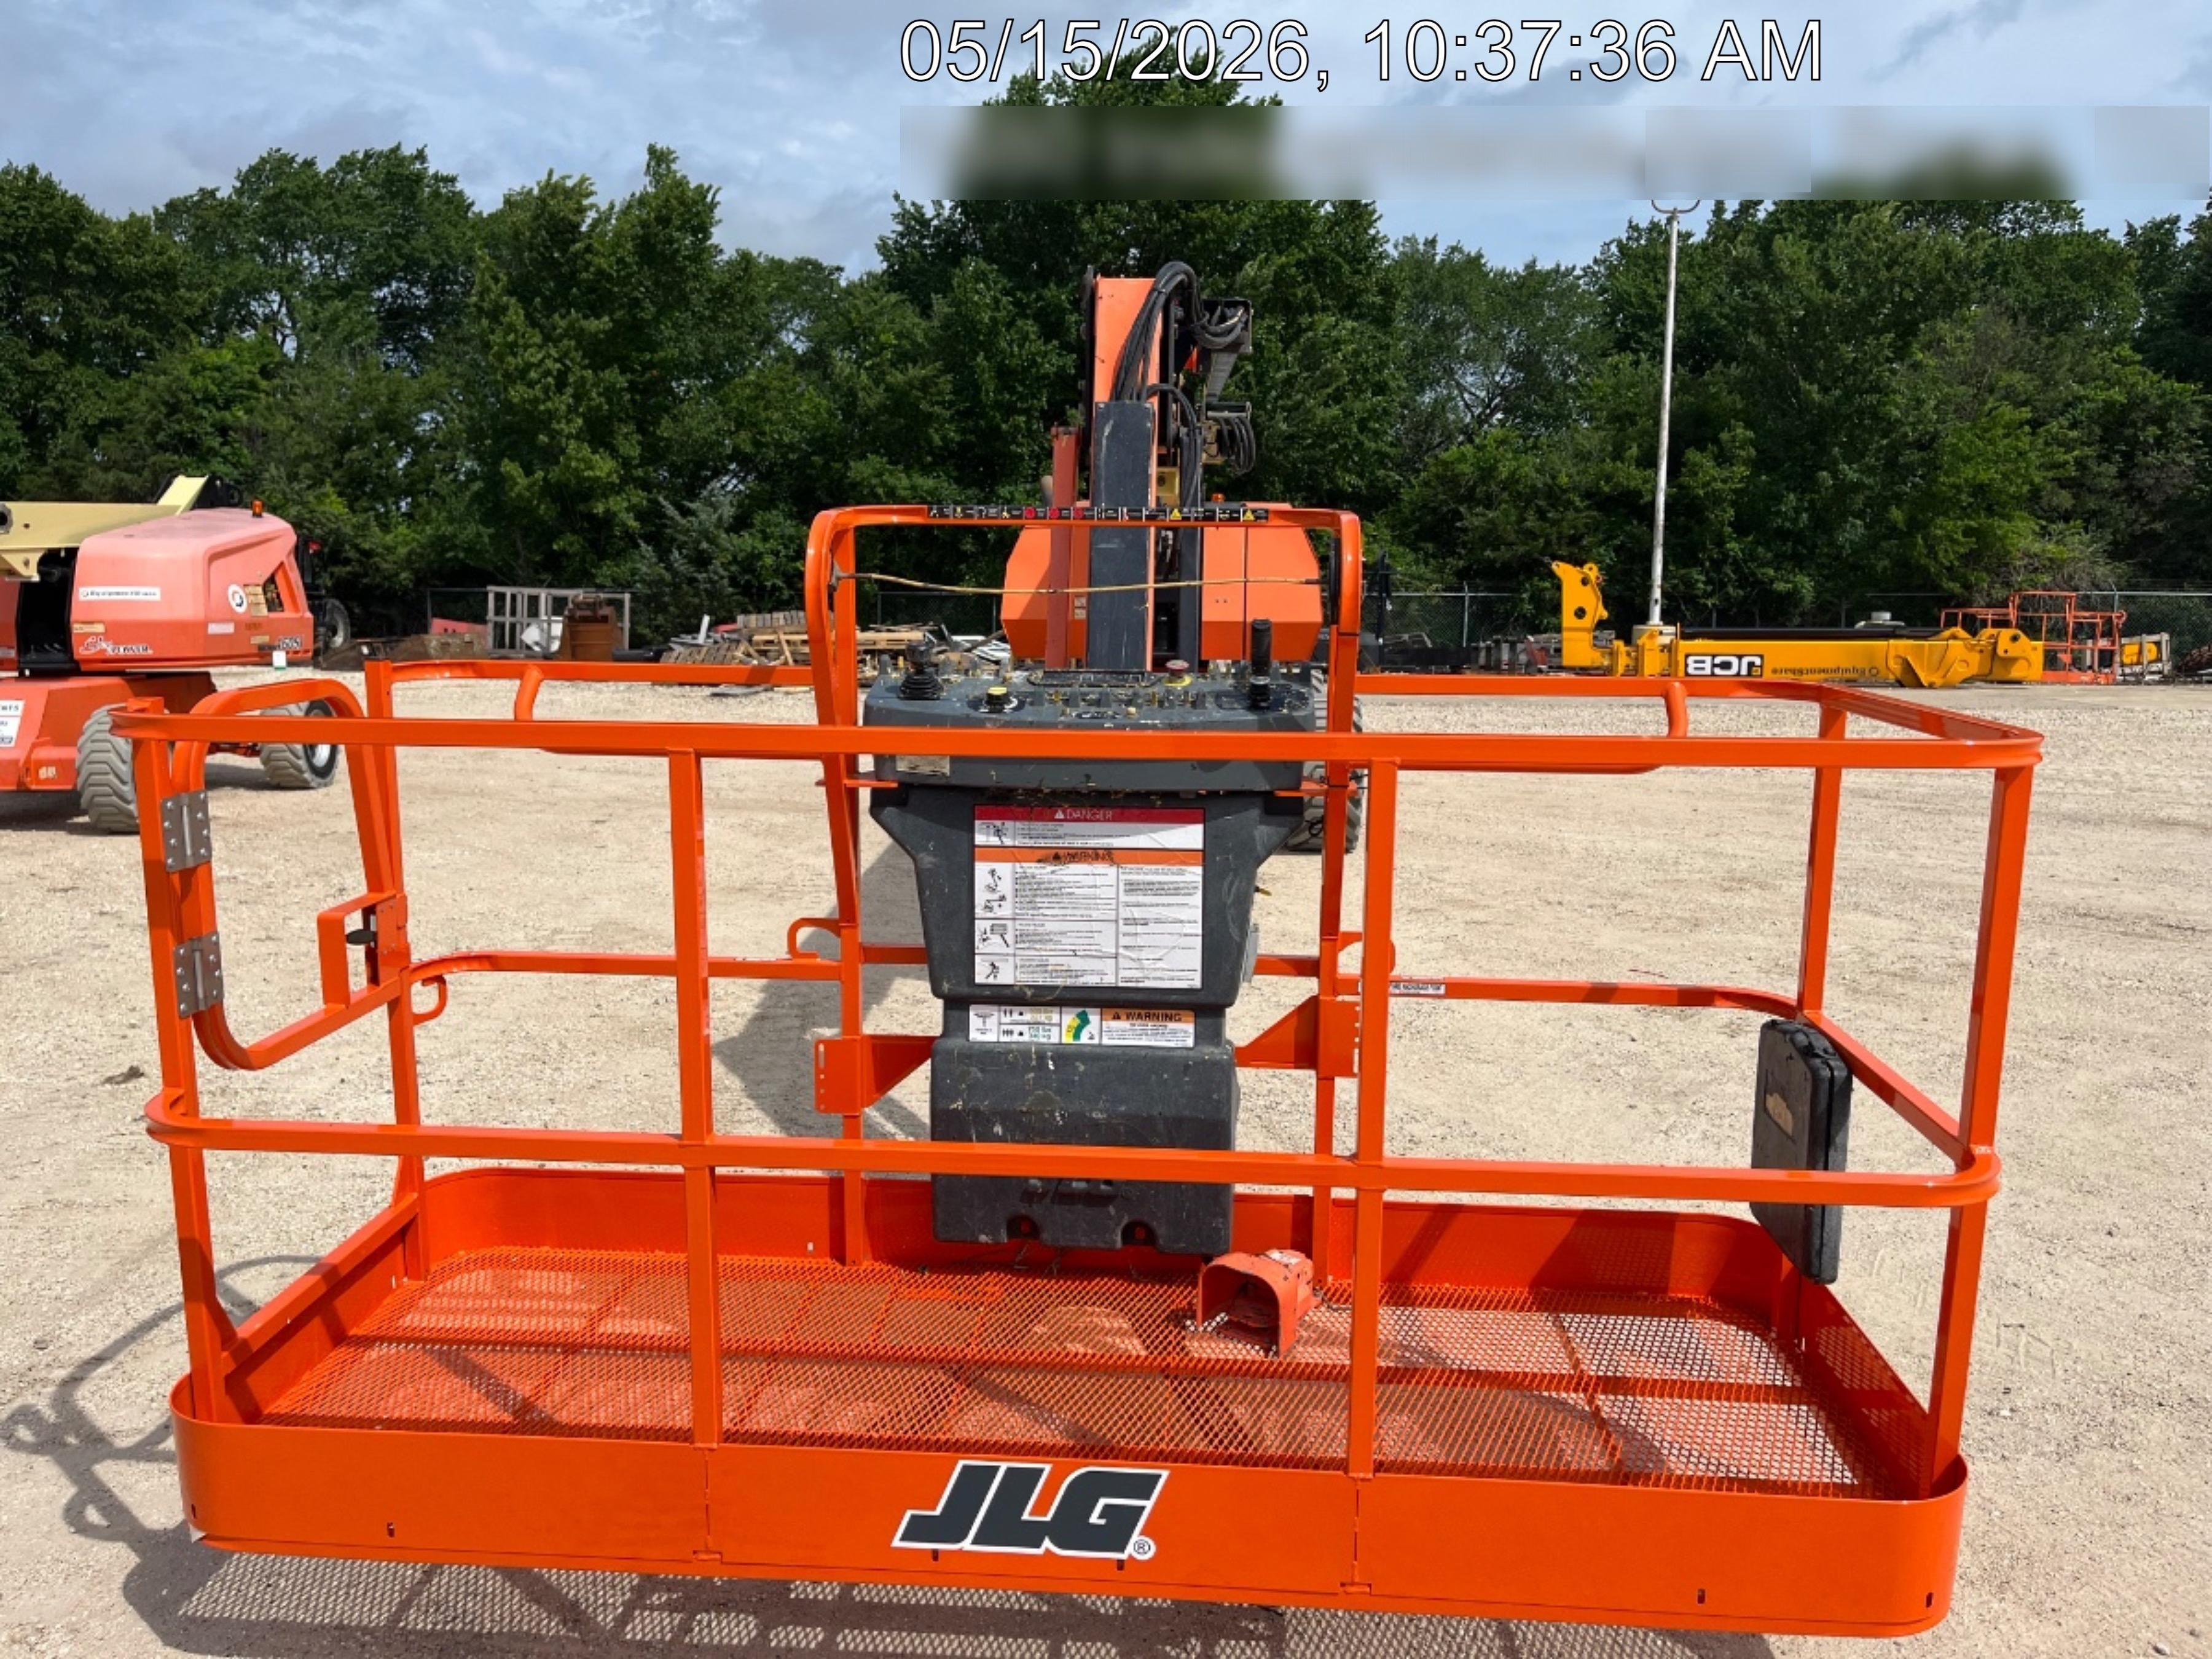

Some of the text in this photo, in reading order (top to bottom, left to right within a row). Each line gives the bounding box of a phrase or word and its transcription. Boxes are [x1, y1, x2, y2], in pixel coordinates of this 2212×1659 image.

[1687, 656, 1762, 675] JCB
[1067, 809, 1113, 821] DANGER
[1126, 1011, 1182, 1022] WARNING
